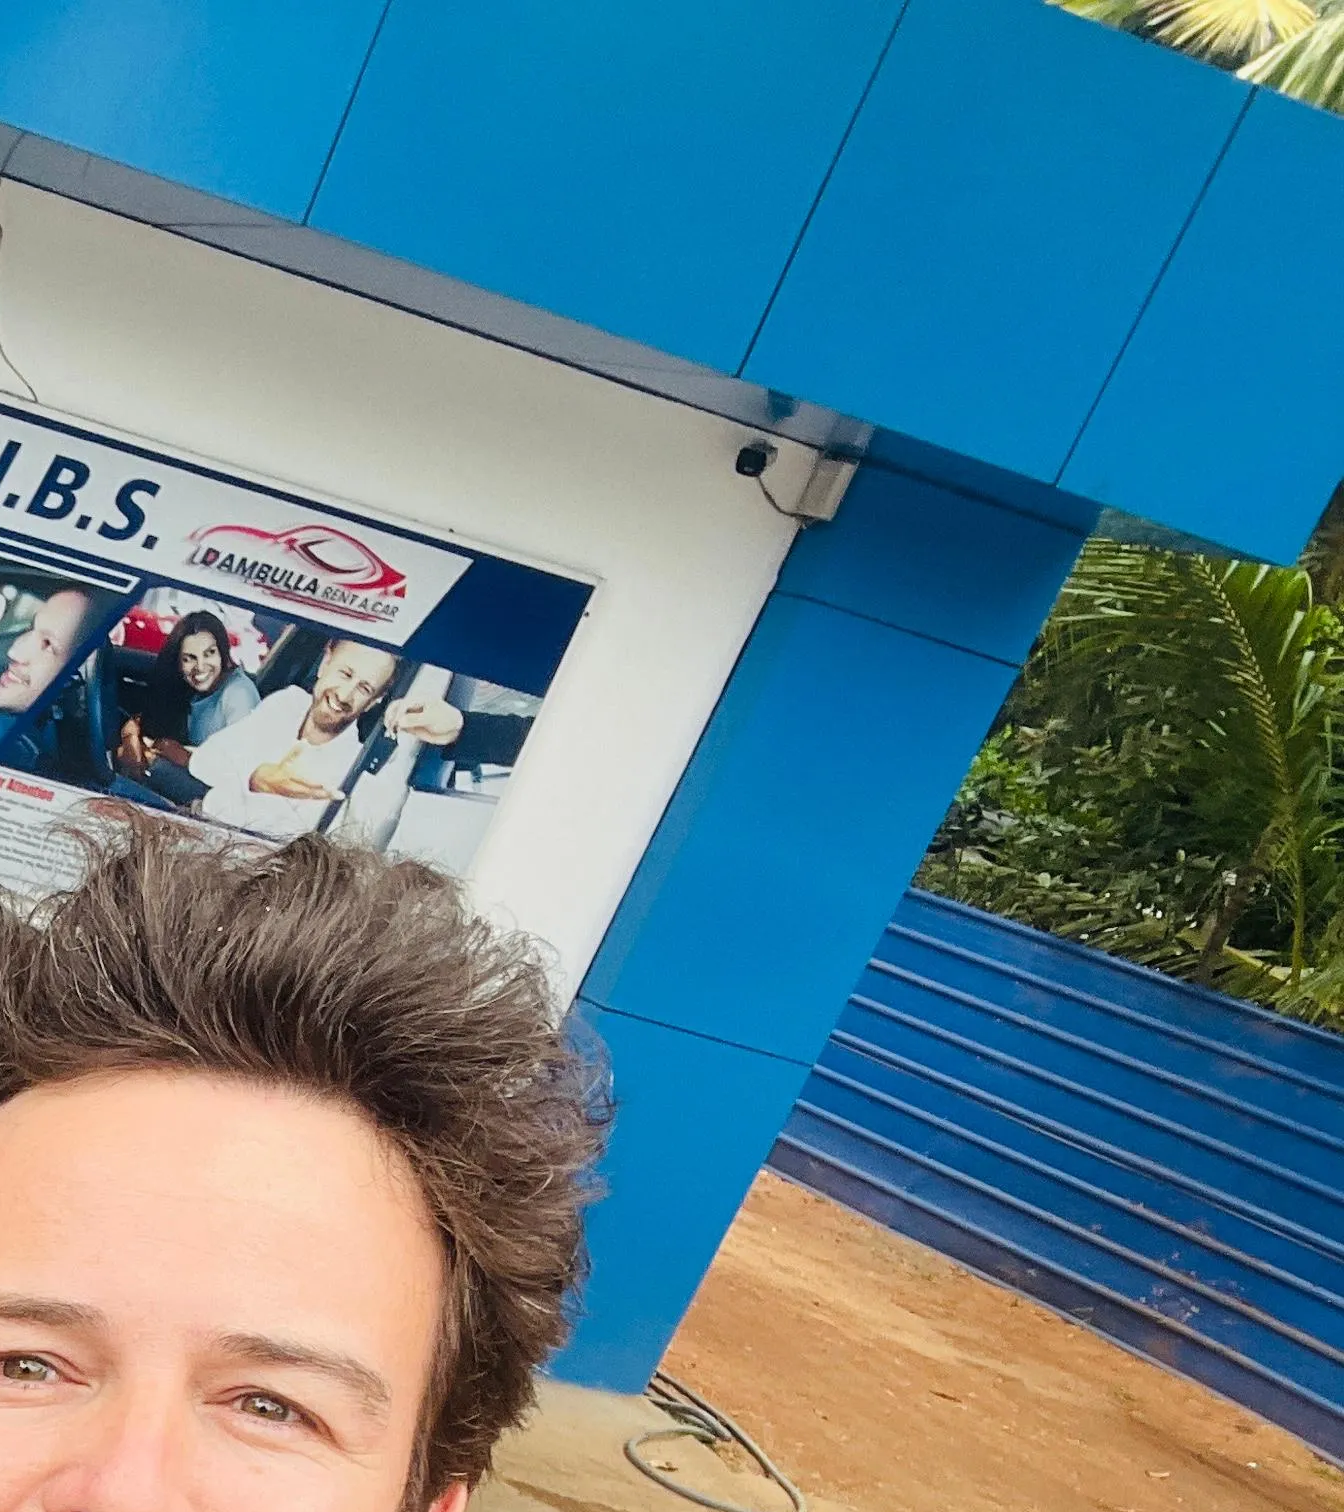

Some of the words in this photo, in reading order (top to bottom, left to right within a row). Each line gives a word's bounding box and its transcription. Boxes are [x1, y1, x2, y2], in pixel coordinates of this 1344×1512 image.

[201, 547, 319, 595] DAMBULLA
[321, 586, 357, 606] RENT
[371, 600, 400, 618] CAR
